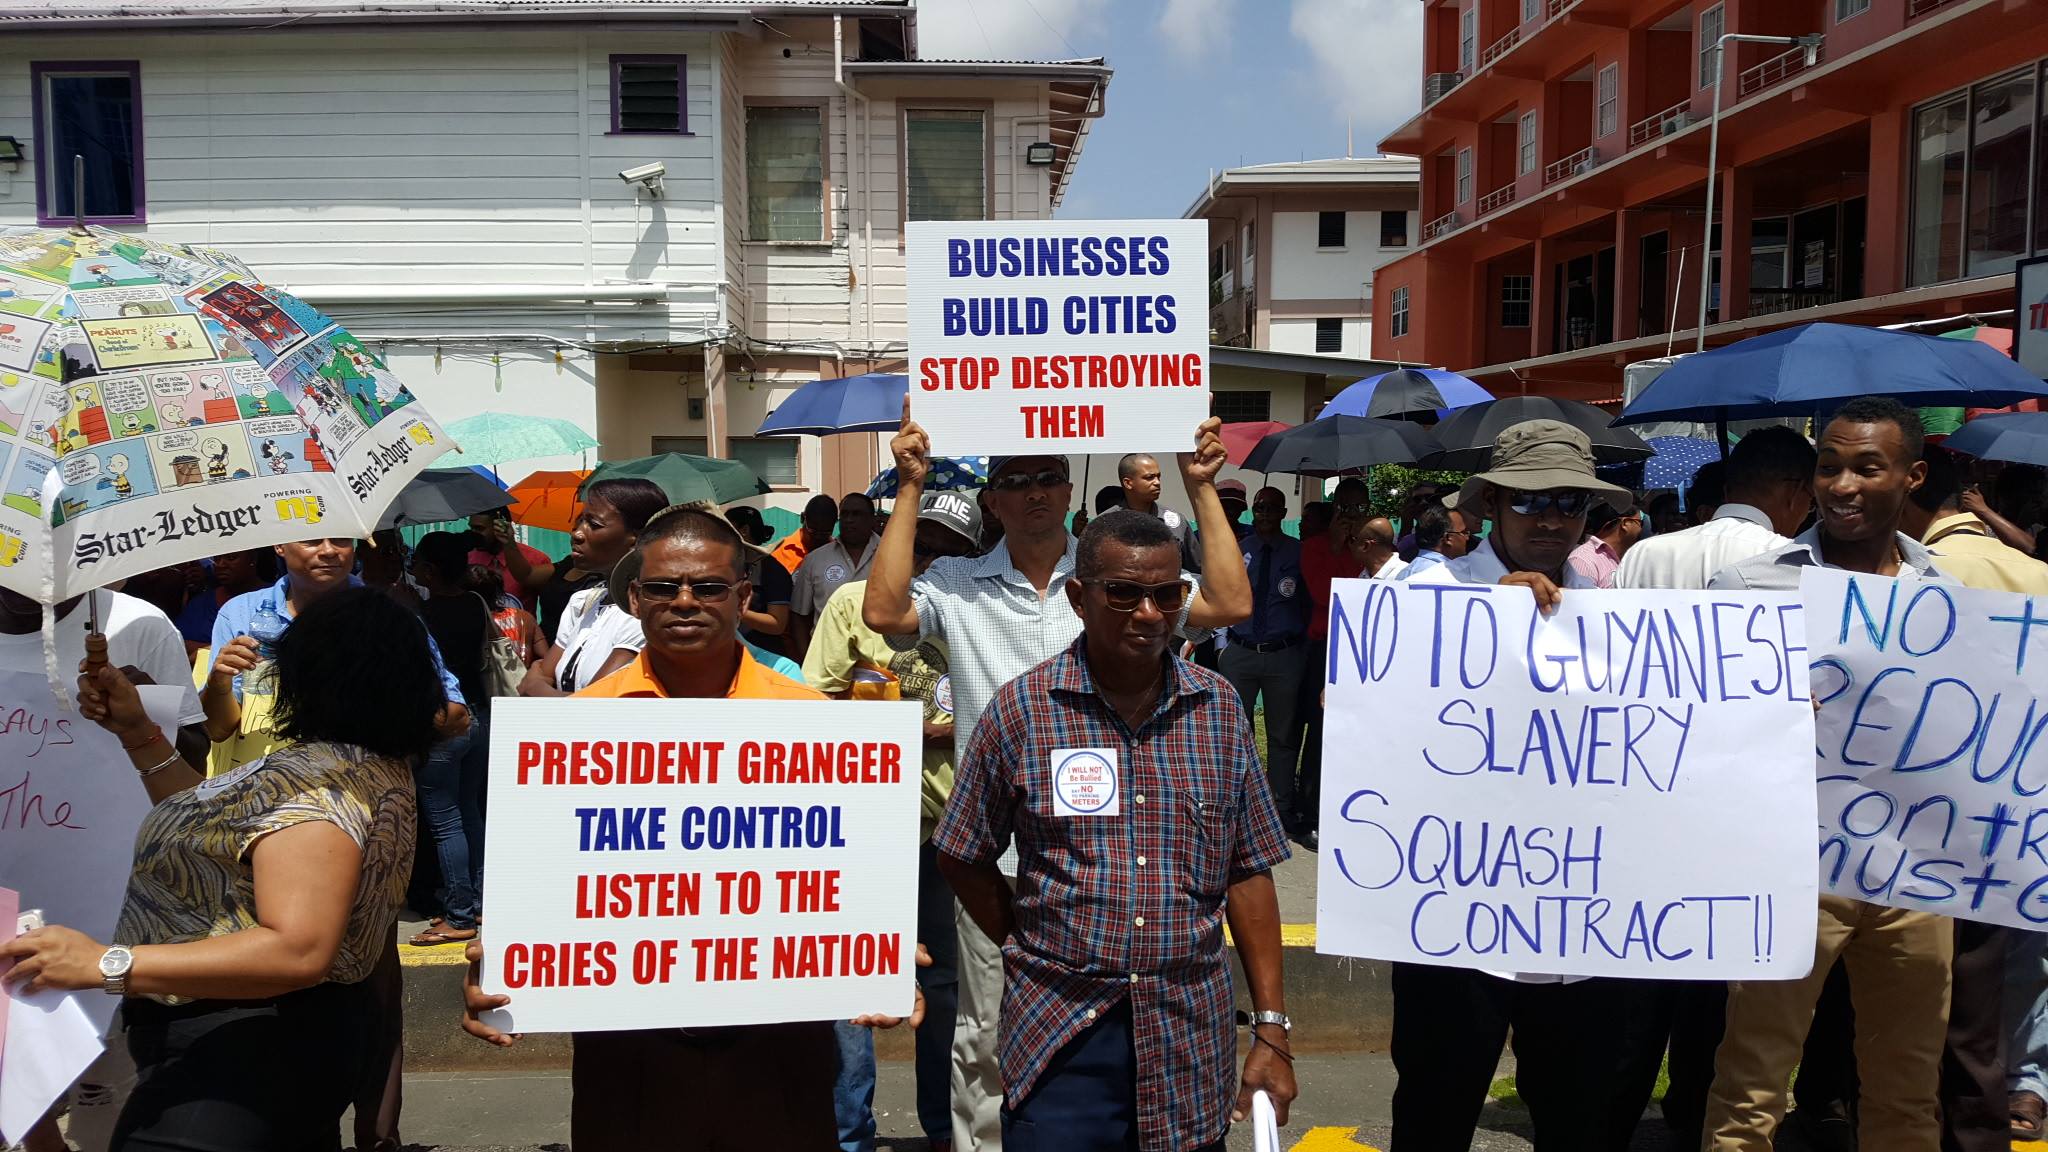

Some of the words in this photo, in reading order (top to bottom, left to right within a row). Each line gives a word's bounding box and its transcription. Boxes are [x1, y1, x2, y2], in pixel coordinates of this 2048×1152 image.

[950, 237, 1169, 276] BUSINESSES
[89, 329, 137, 337] PEANUTS
[944, 298, 1048, 336] BUILD
[1064, 295, 1176, 333] CITIES
[920, 357, 1000, 391] STOP
[1012, 353, 1202, 390] DESTROYING
[1020, 404, 1105, 439] THEM
[263, 488, 312, 499] POWERING
[75, 502, 261, 569] Star-Ledger
[1838, 574, 1957, 658] NO
[1328, 583, 1399, 684] NO
[1408, 584, 1498, 690] TO
[1526, 602, 1809, 703] GUYANESE
[517, 740, 725, 785] PRESIDENT
[737, 740, 902, 785] GRANGER
[1422, 698, 1694, 793] SLAVERY
[1072, 766, 1088, 774] WILL
[1089, 766, 1102, 774] NOT
[1081, 785, 1093, 793] NO
[576, 807, 665, 851] TAKE
[682, 806, 845, 849] CONTROL
[1333, 788, 1602, 894] SQUASH
[575, 872, 701, 920] LISTEN
[715, 870, 762, 916] TO
[776, 869, 841, 913] THE
[503, 940, 617, 989] CRIES
[633, 939, 679, 985] OF
[691, 937, 759, 982] THE
[772, 932, 901, 979] NATION
